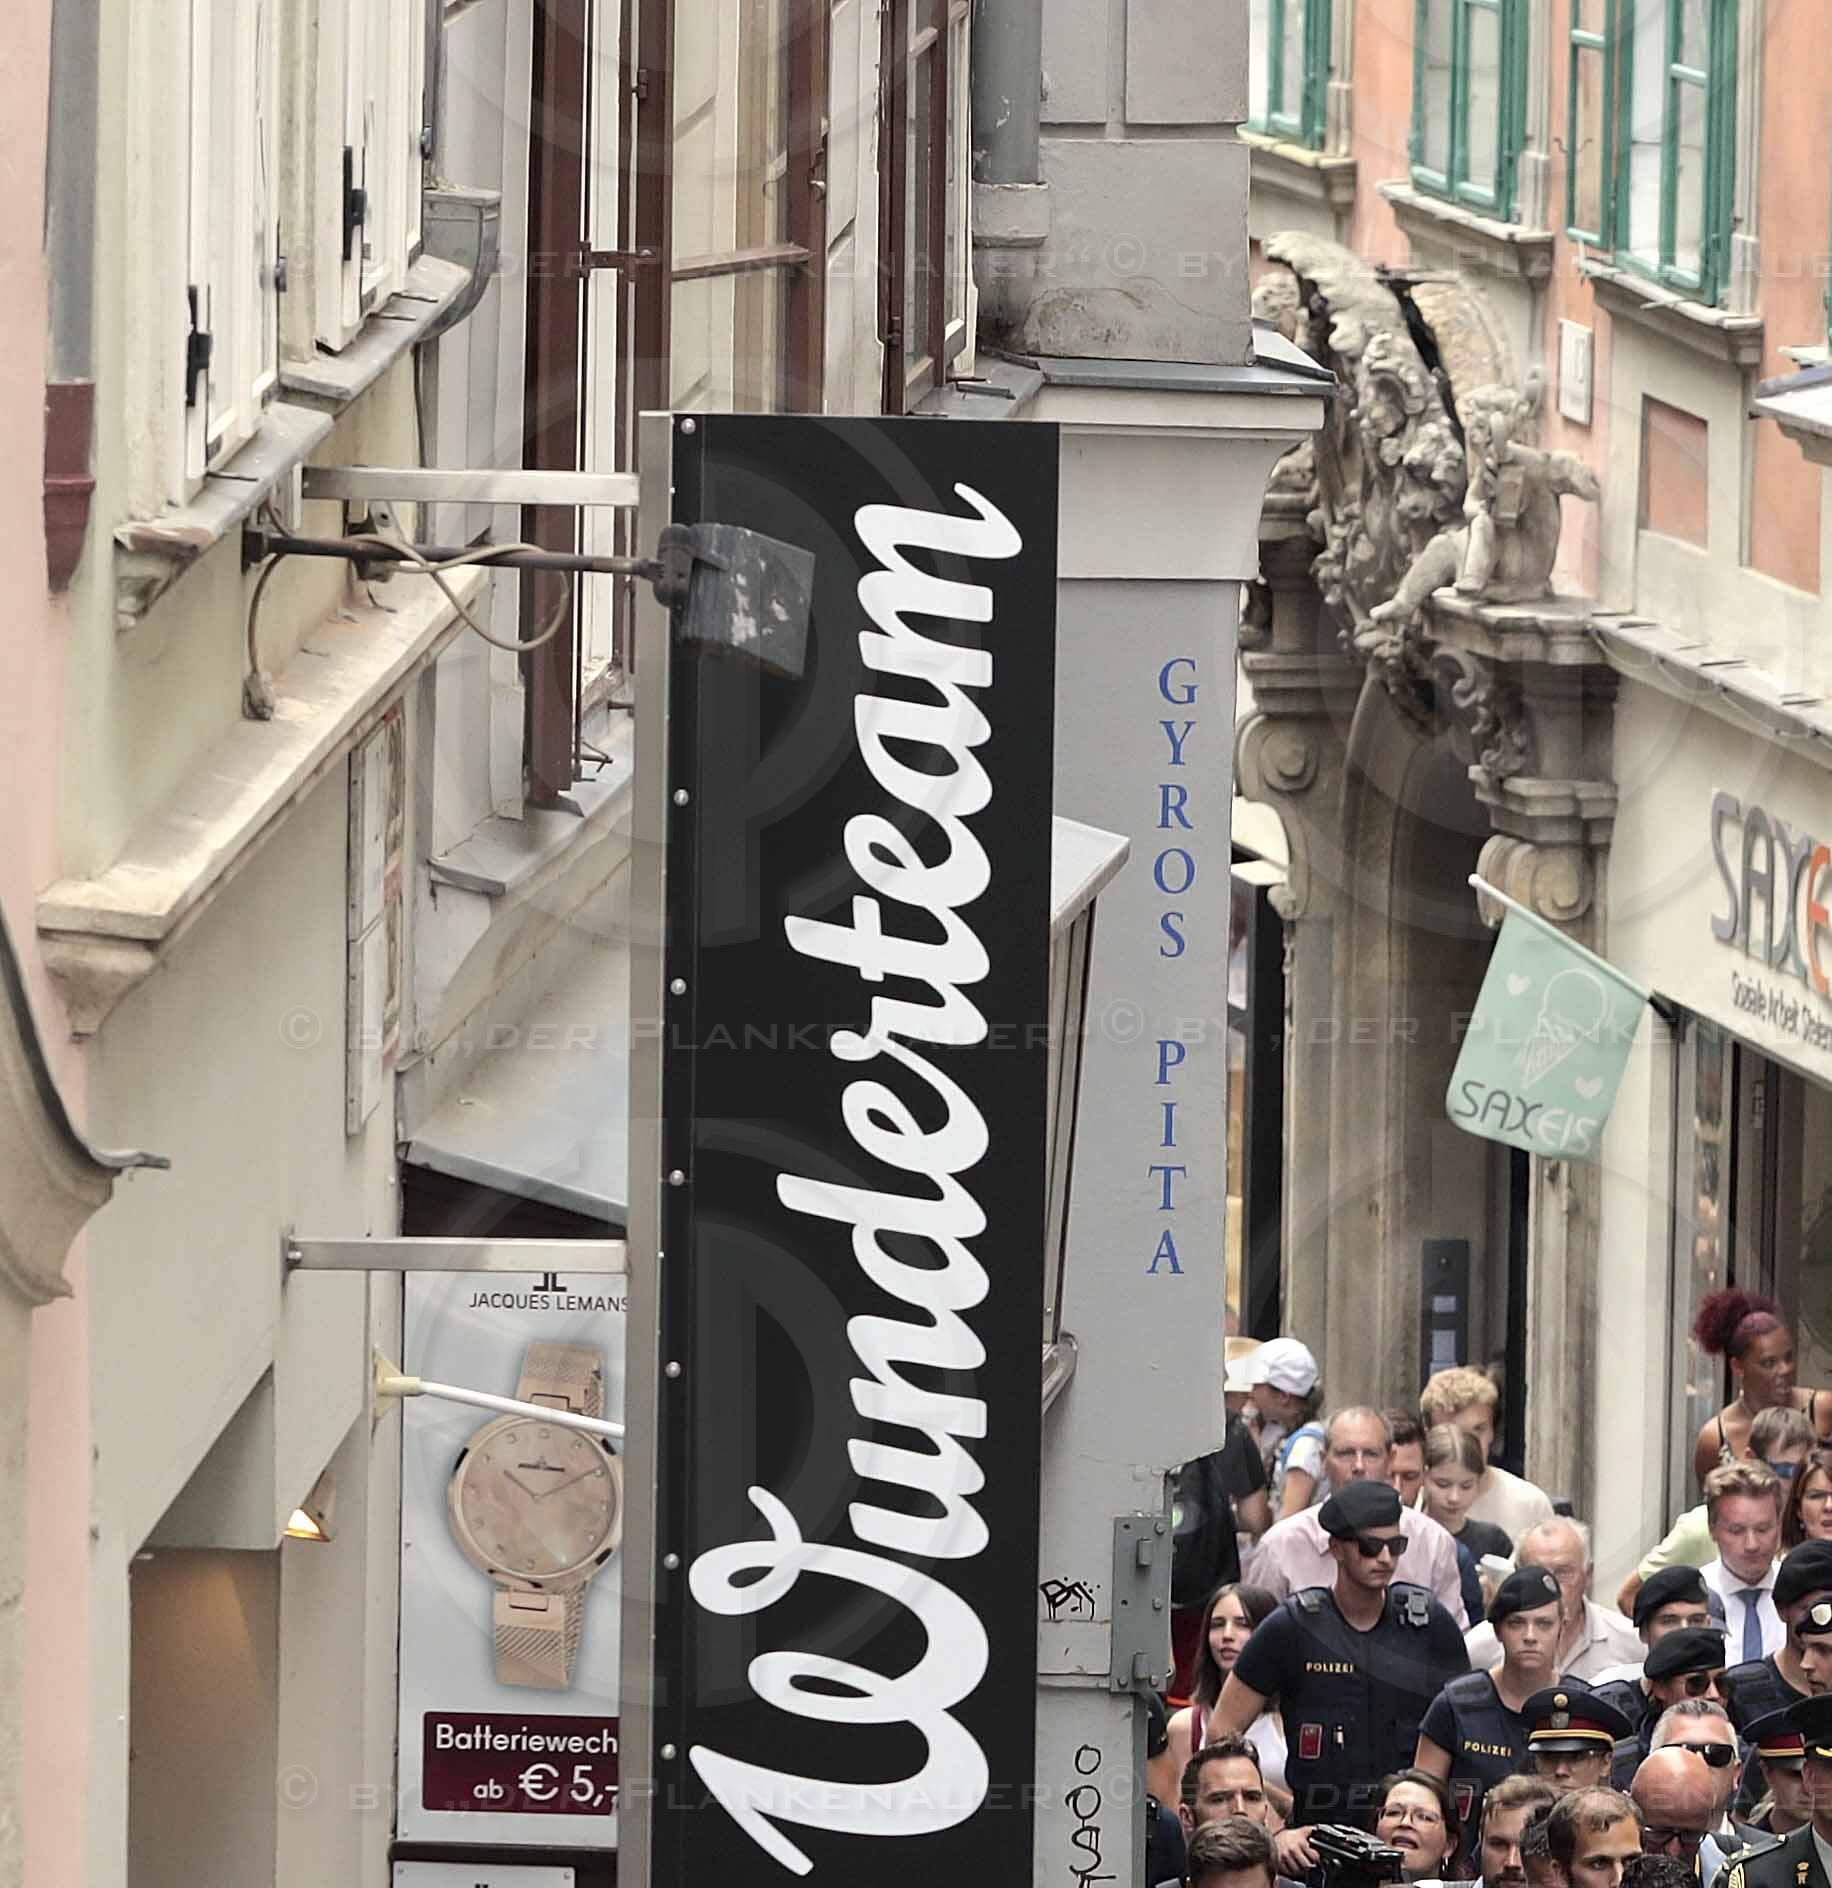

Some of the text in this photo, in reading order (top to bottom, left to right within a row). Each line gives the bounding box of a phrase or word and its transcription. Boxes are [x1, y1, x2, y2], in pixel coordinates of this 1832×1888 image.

[1146, 657, 1198, 1275] GYROS PITA
[1453, 1080, 1598, 1155] SAXEIS
[688, 482, 1022, 1876] Wunderteam
[469, 1291, 549, 1314] JACQUES
[1463, 1740, 1512, 1757] POLIZEI
[473, 1779, 504, 1800] ab
